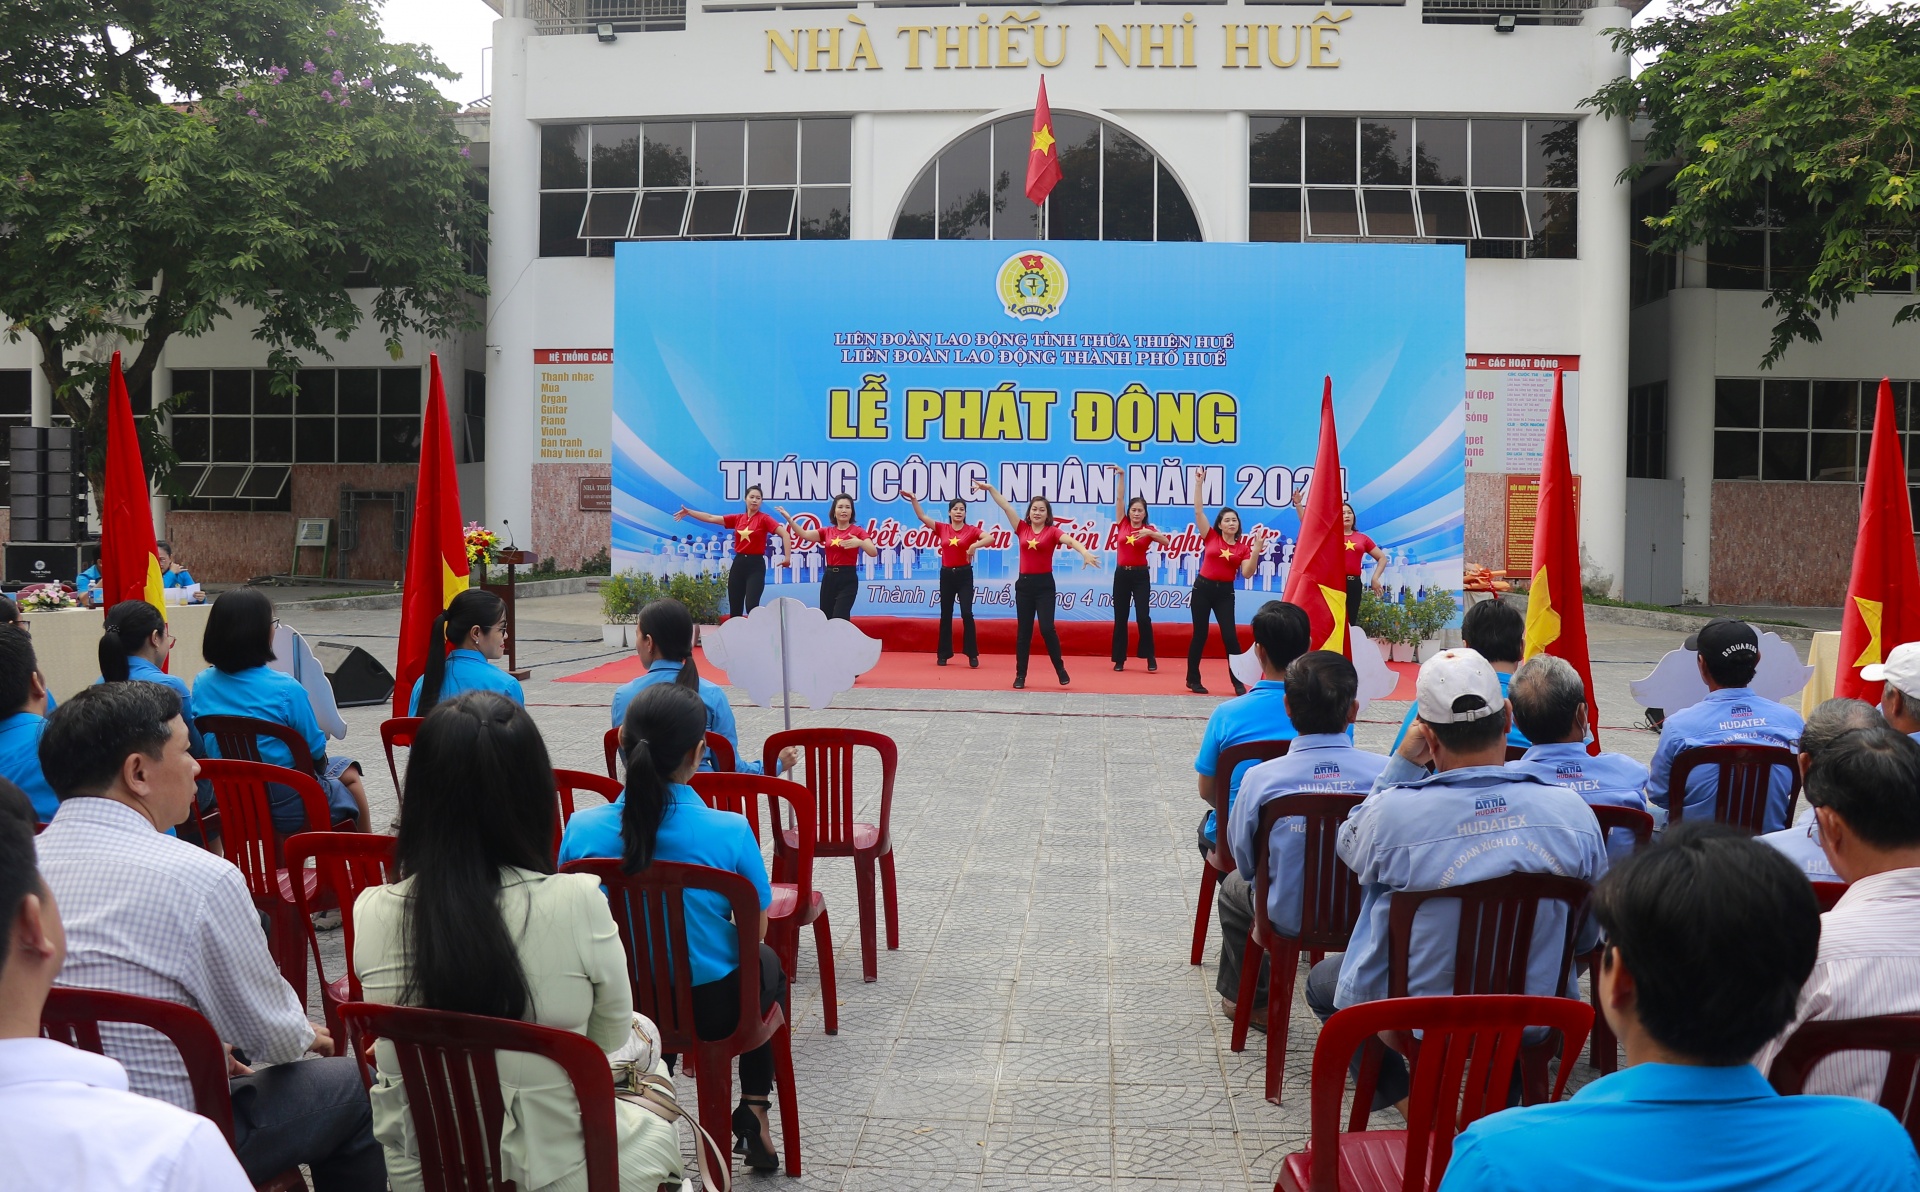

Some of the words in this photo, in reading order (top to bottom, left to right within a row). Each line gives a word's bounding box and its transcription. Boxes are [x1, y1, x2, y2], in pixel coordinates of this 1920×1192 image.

[764, 13, 883, 73] NHÀ
[1222, 10, 1353, 70] HUẾ
[834, 331, 877, 346] LIÊN
[881, 330, 932, 346] ĐOÀN
[935, 332, 972, 346] LAO
[975, 331, 1028, 349] ĐỘNG
[1031, 331, 1077, 347] TỈNH
[1080, 332, 1130, 348] THỪA
[1134, 333, 1192, 349] THIÊN
[1195, 333, 1234, 349] HUẾ
[549, 351, 560, 363] HỆ
[562, 350, 589, 362] THỐNG
[591, 351, 608, 362] CÁC
[841, 347, 889, 363] LIÊN
[893, 347, 950, 363] ĐOÀN
[953, 349, 994, 363] LAO
[998, 348, 1057, 367] ĐỘNG
[1061, 348, 1131, 365] THÀNH
[1135, 348, 1179, 366] PHỐ
[1183, 350, 1227, 366] HUẾ
[1488, 357, 1506, 367] CÁC
[1509, 358, 1531, 369] HOẠT
[1534, 358, 1559, 369] ĐỘNG
[541, 372, 569, 381] Thanh
[541, 394, 567, 404] Organ
[1477, 389, 1494, 401] đẹp
[541, 405, 568, 414] Guitar
[828, 373, 888, 439] LỄ
[905, 382, 1058, 441] PHÁT
[1072, 383, 1238, 452] ĐỘNG
[541, 415, 565, 425] Piano
[1466, 411, 1488, 423] sóng
[541, 426, 567, 436] Violon
[560, 438, 582, 447] tranh
[720, 455, 858, 501] THÁNG
[870, 455, 988, 503] CÔNG
[1001, 457, 1115, 504] NHÂN
[1128, 458, 1224, 507] NĂM
[903, 522, 943, 556] côn
[867, 585, 925, 604] Thành
[1081, 589, 1094, 606] 4
[1148, 590, 1193, 608] 2024
[1719, 717, 1767, 730] HUDATEX
[1298, 780, 1357, 792] HUDATEX
[1475, 807, 1508, 816] HUDATEX
[1456, 814, 1528, 837] HUDATEX
[1453, 845, 1481, 869] ĐOÀN
[1481, 838, 1504, 852] XÍCH
[1505, 835, 1518, 847] LÔ
[1526, 841, 1538, 854] XE
